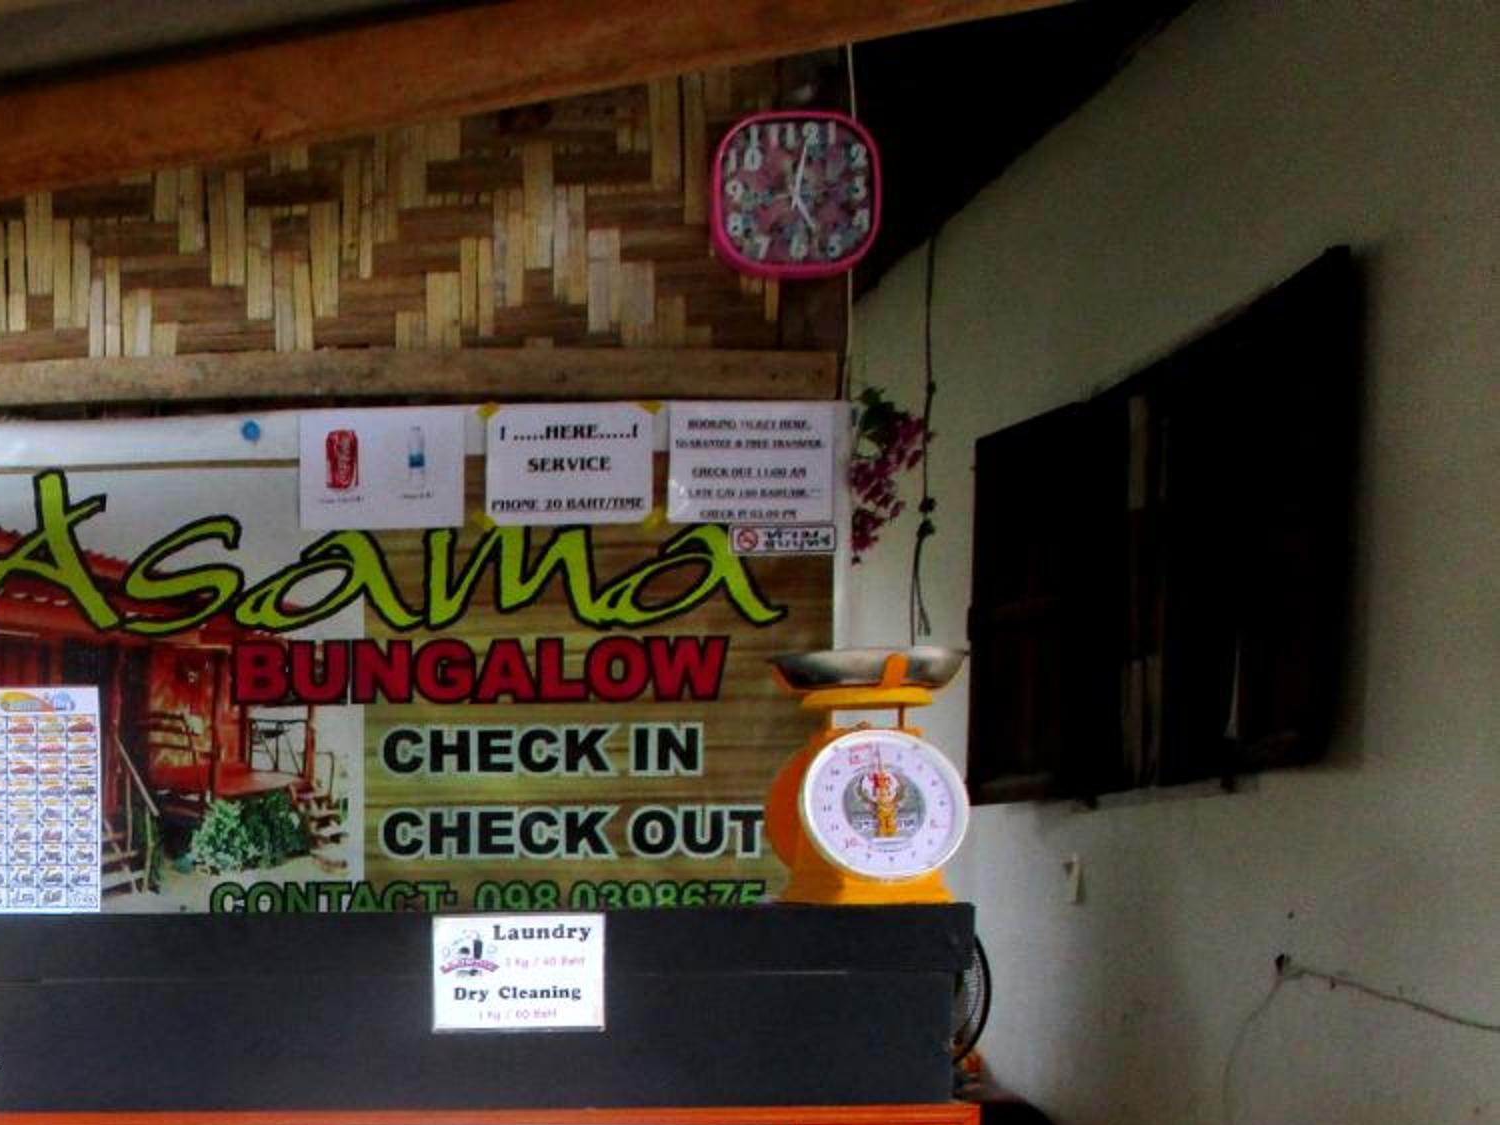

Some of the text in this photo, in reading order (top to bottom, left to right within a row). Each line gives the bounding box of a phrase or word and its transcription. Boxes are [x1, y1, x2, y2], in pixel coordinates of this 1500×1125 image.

[527, 456, 612, 473] SERVICE
[691, 466, 729, 478] CHECK
[731, 466, 753, 478] OUT
[491, 497, 645, 512] PHONE 20 BAHT/TIME
[700, 508, 735, 520] CHECK
[232, 634, 730, 704] BUNGALOW
[381, 725, 700, 775] CHECK IN
[381, 808, 765, 857] CHECK OUT
[473, 879, 561, 911] 098
[493, 923, 592, 942] Laundry
[453, 985, 582, 1003] Dry Cleaning
